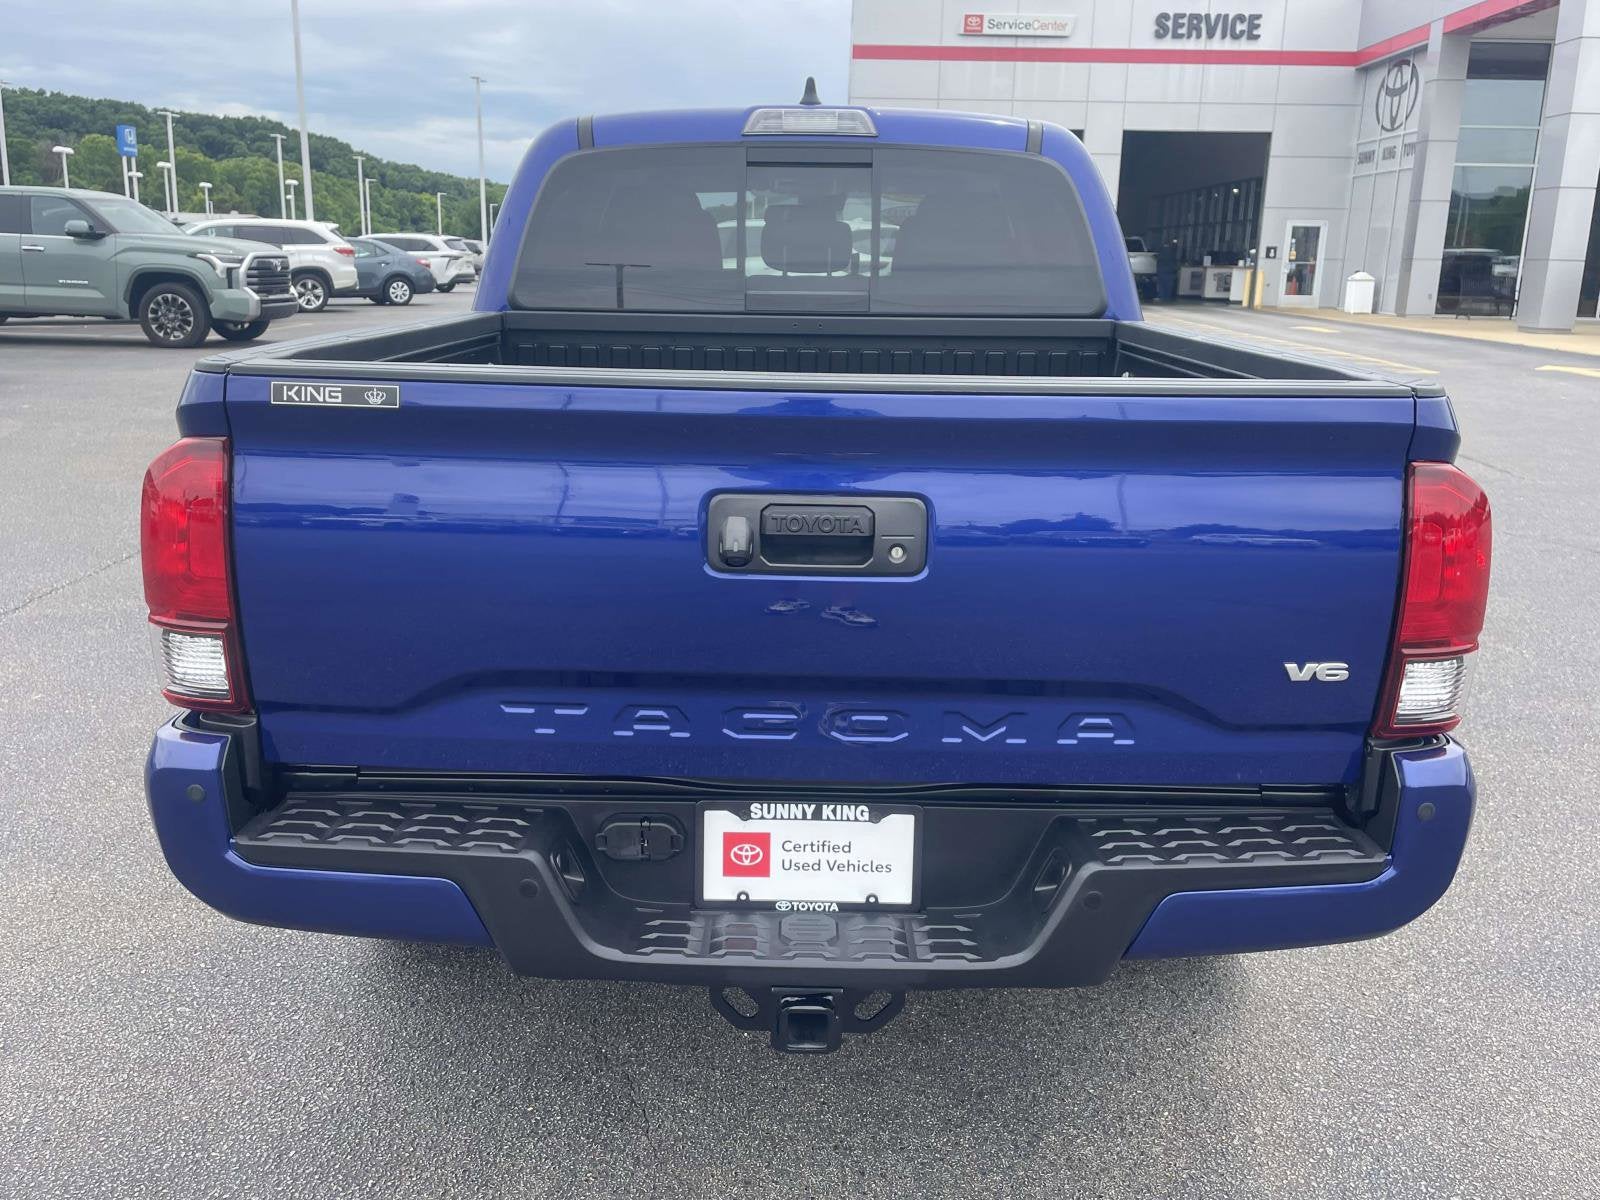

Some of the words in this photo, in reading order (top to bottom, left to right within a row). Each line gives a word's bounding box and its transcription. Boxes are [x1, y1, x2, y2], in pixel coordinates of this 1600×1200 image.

[1154, 12, 1263, 40] SERVICE
[283, 385, 342, 402] KING
[771, 514, 864, 534] TOYOTA
[1284, 662, 1349, 682] V6
[500, 701, 1136, 745] TACOMA
[750, 803, 816, 820] SUNNY
[822, 804, 870, 821] KING
[781, 840, 852, 854] Certified
[781, 859, 821, 872] Used
[826, 860, 892, 874] Vehicles
[792, 901, 839, 912] TOYOTA
